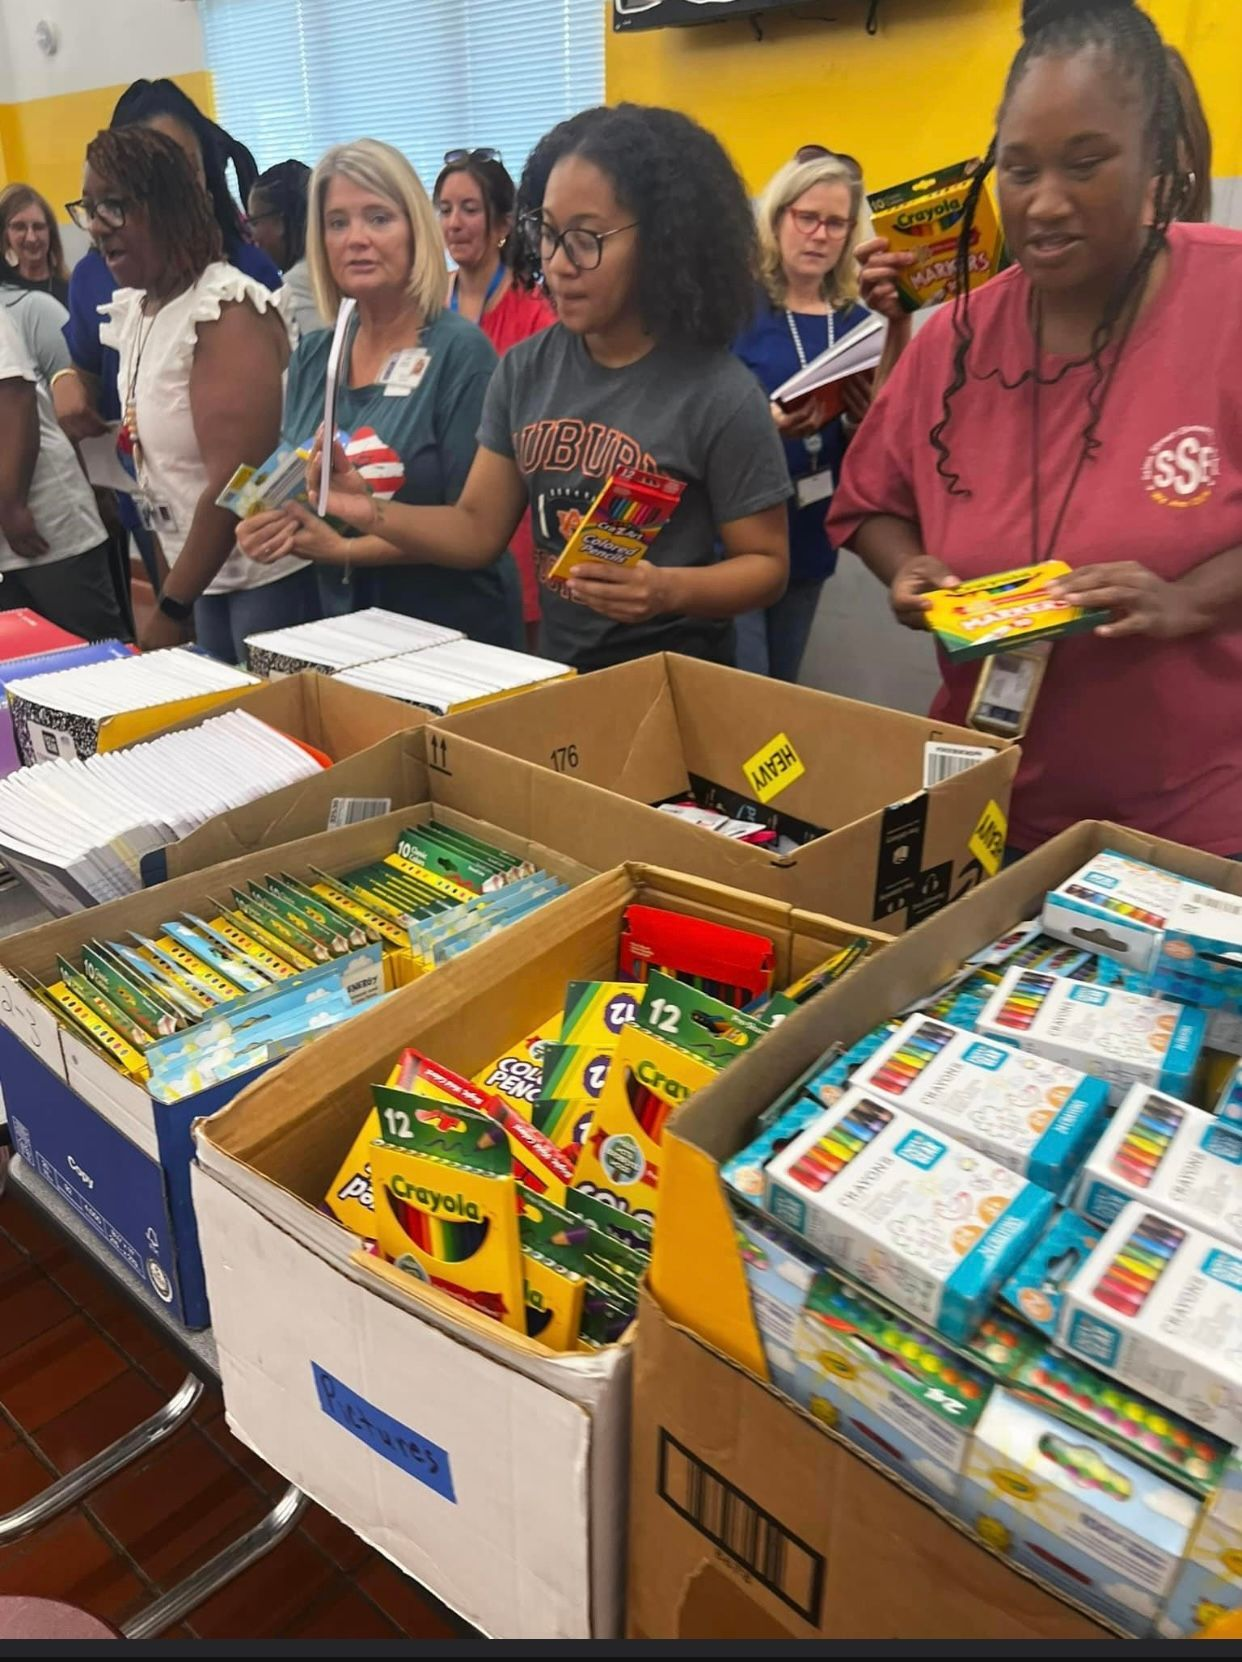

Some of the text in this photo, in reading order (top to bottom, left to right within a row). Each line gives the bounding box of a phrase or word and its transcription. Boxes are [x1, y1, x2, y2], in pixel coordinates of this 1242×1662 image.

[897, 198, 962, 228] Crayola
[910, 252, 990, 290] MARKRS
[512, 418, 672, 478] UBUR
[620, 468, 634, 479] 12
[580, 544, 629, 564] Pencils
[583, 534, 640, 556] Colored
[550, 744, 579, 772] 176
[751, 744, 797, 791] HEAVY
[398, 841, 411, 858] 10
[649, 998, 681, 1034] 12
[383, 1107, 415, 1138] 12
[391, 1175, 480, 1221] Crayola
